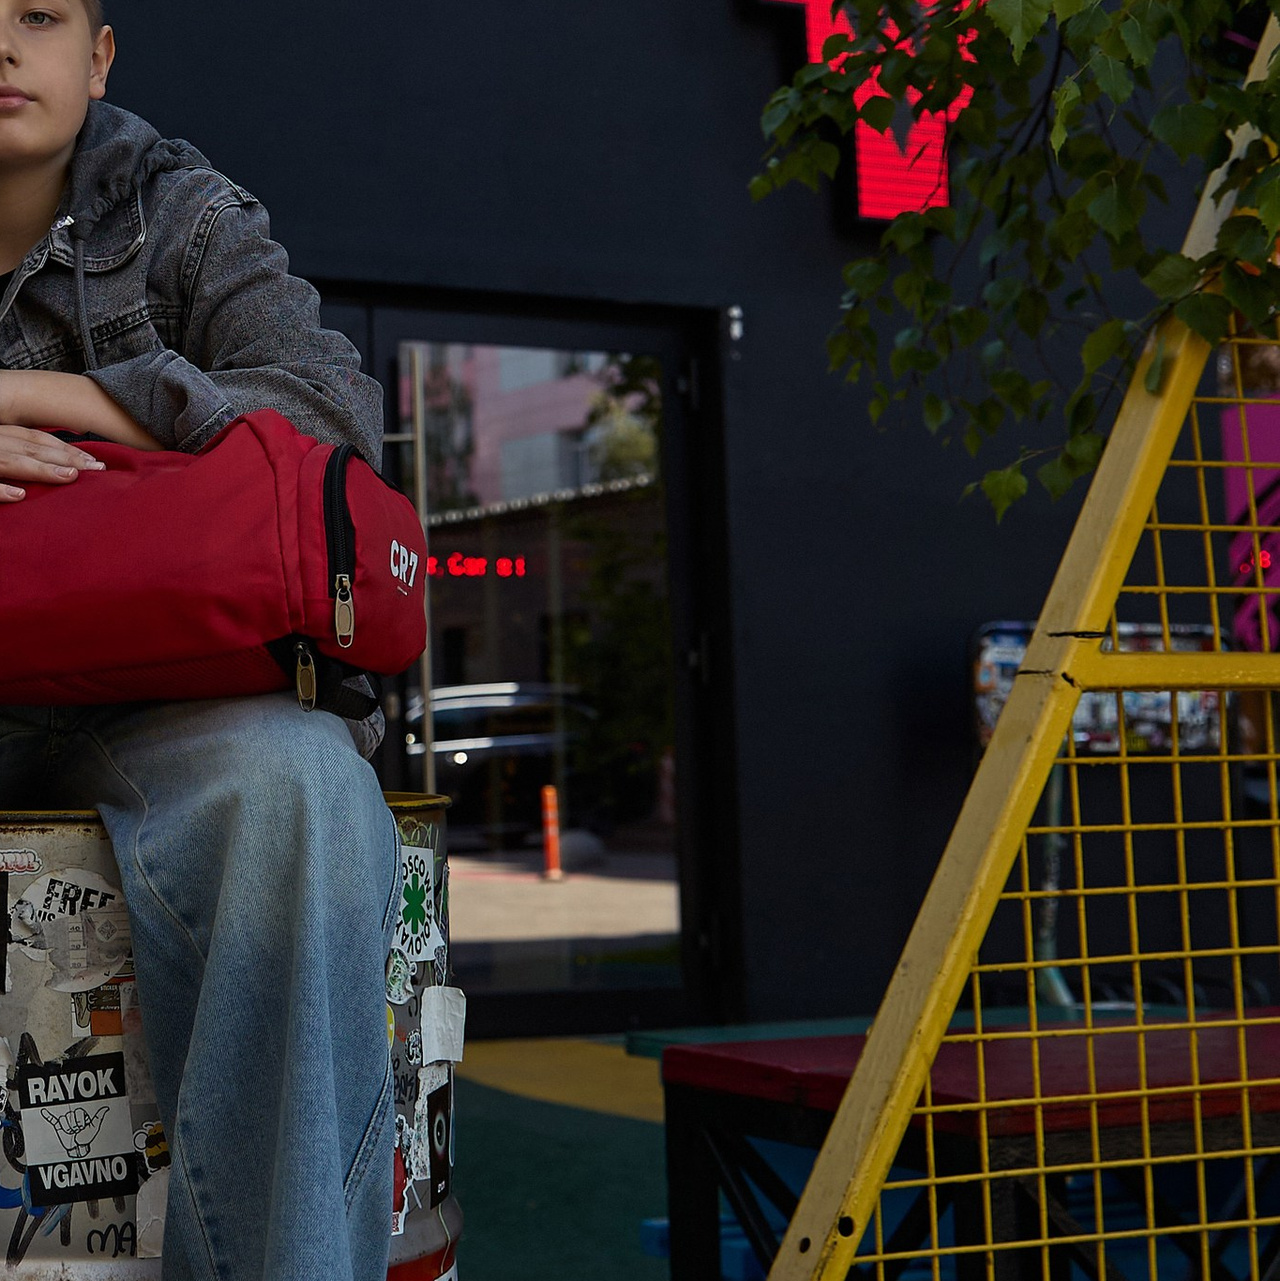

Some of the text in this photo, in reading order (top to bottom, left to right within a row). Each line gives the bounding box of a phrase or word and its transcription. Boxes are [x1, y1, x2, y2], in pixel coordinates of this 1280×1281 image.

[390, 539, 419, 588] CR7
[395, 855, 432, 956] OSCOW STOLOVAY
[27, 1067, 118, 1105] RAYOK
[38, 1156, 128, 1190] VGAVNO
